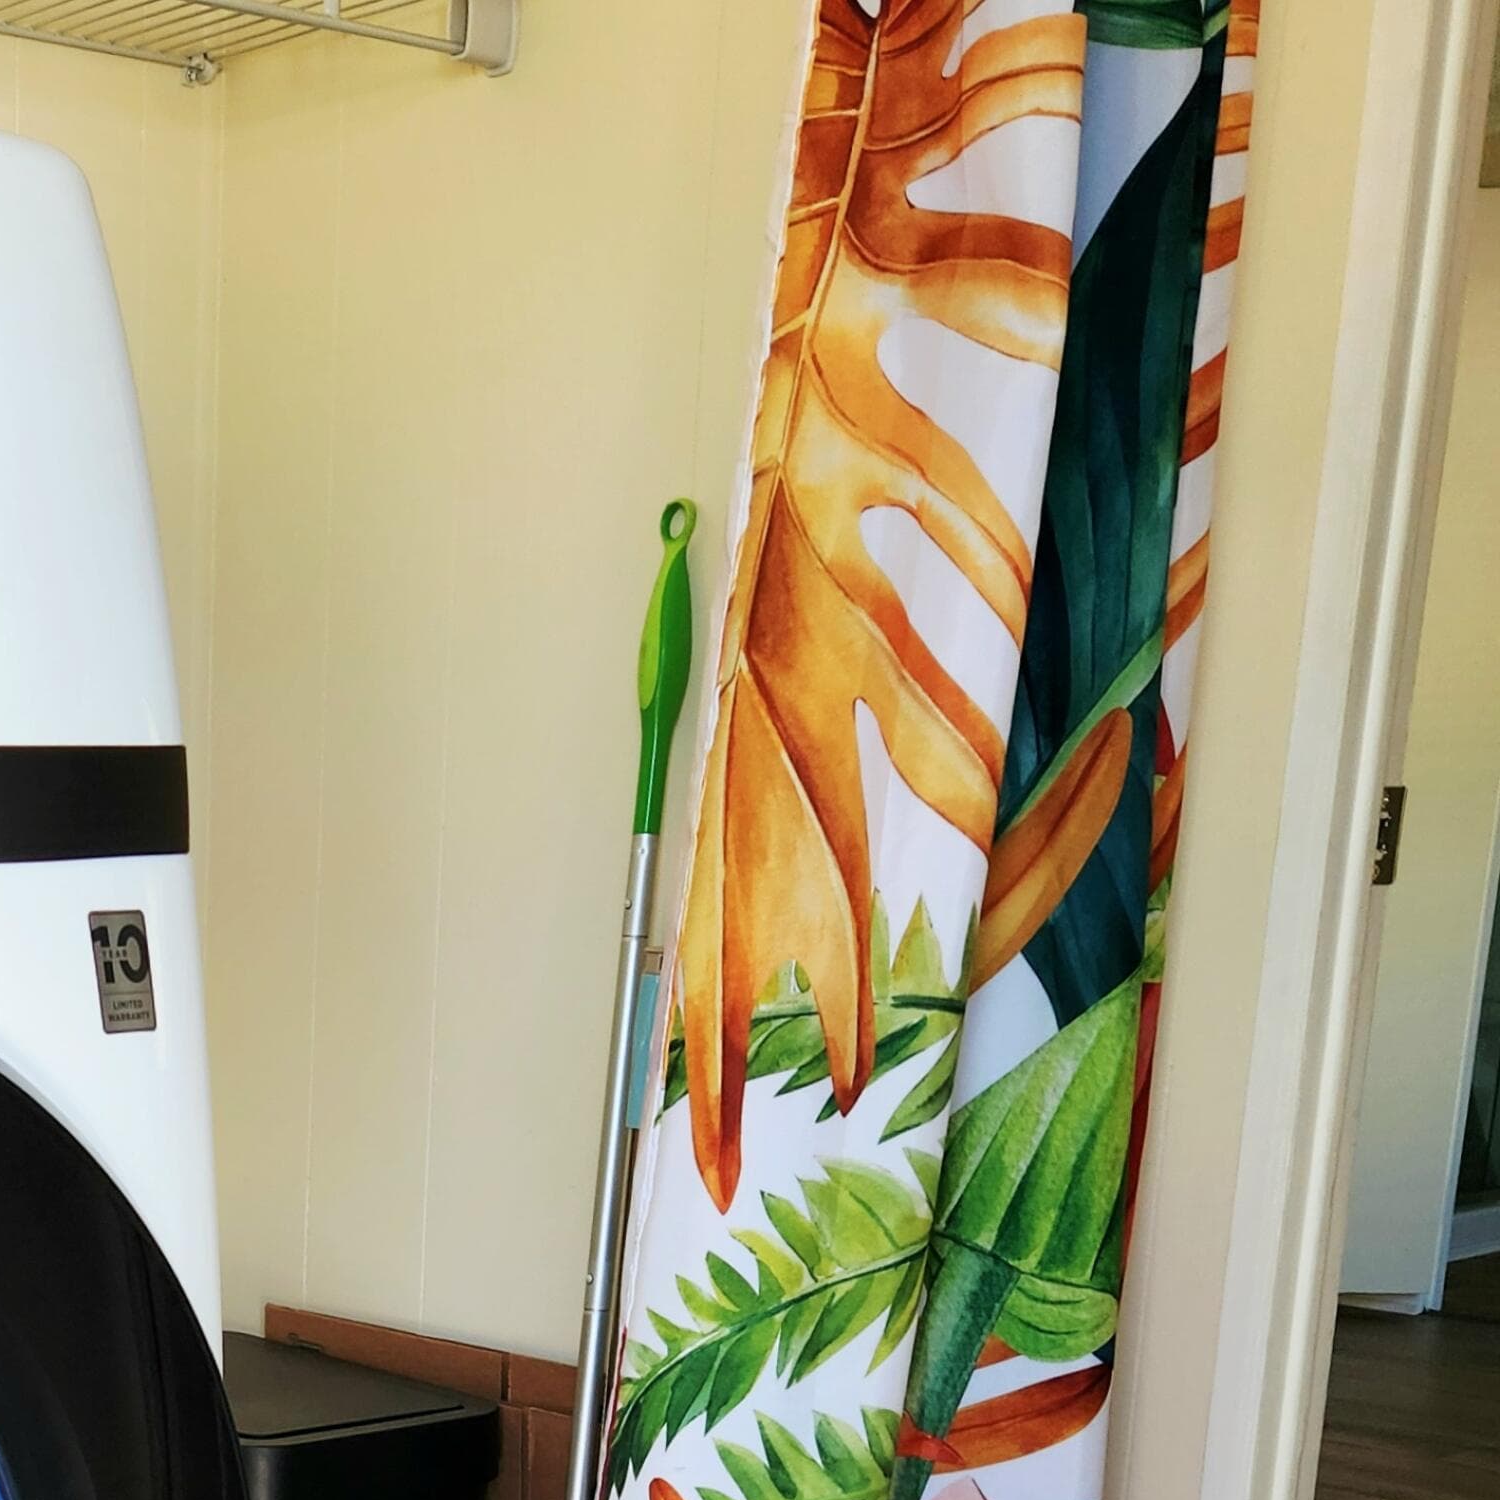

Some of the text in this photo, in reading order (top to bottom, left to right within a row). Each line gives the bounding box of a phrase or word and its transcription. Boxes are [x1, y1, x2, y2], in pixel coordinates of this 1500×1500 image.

[91, 924, 148, 984] 10
[112, 999, 143, 1010] LIMITED
[108, 1011, 150, 1022] WARRANTY
